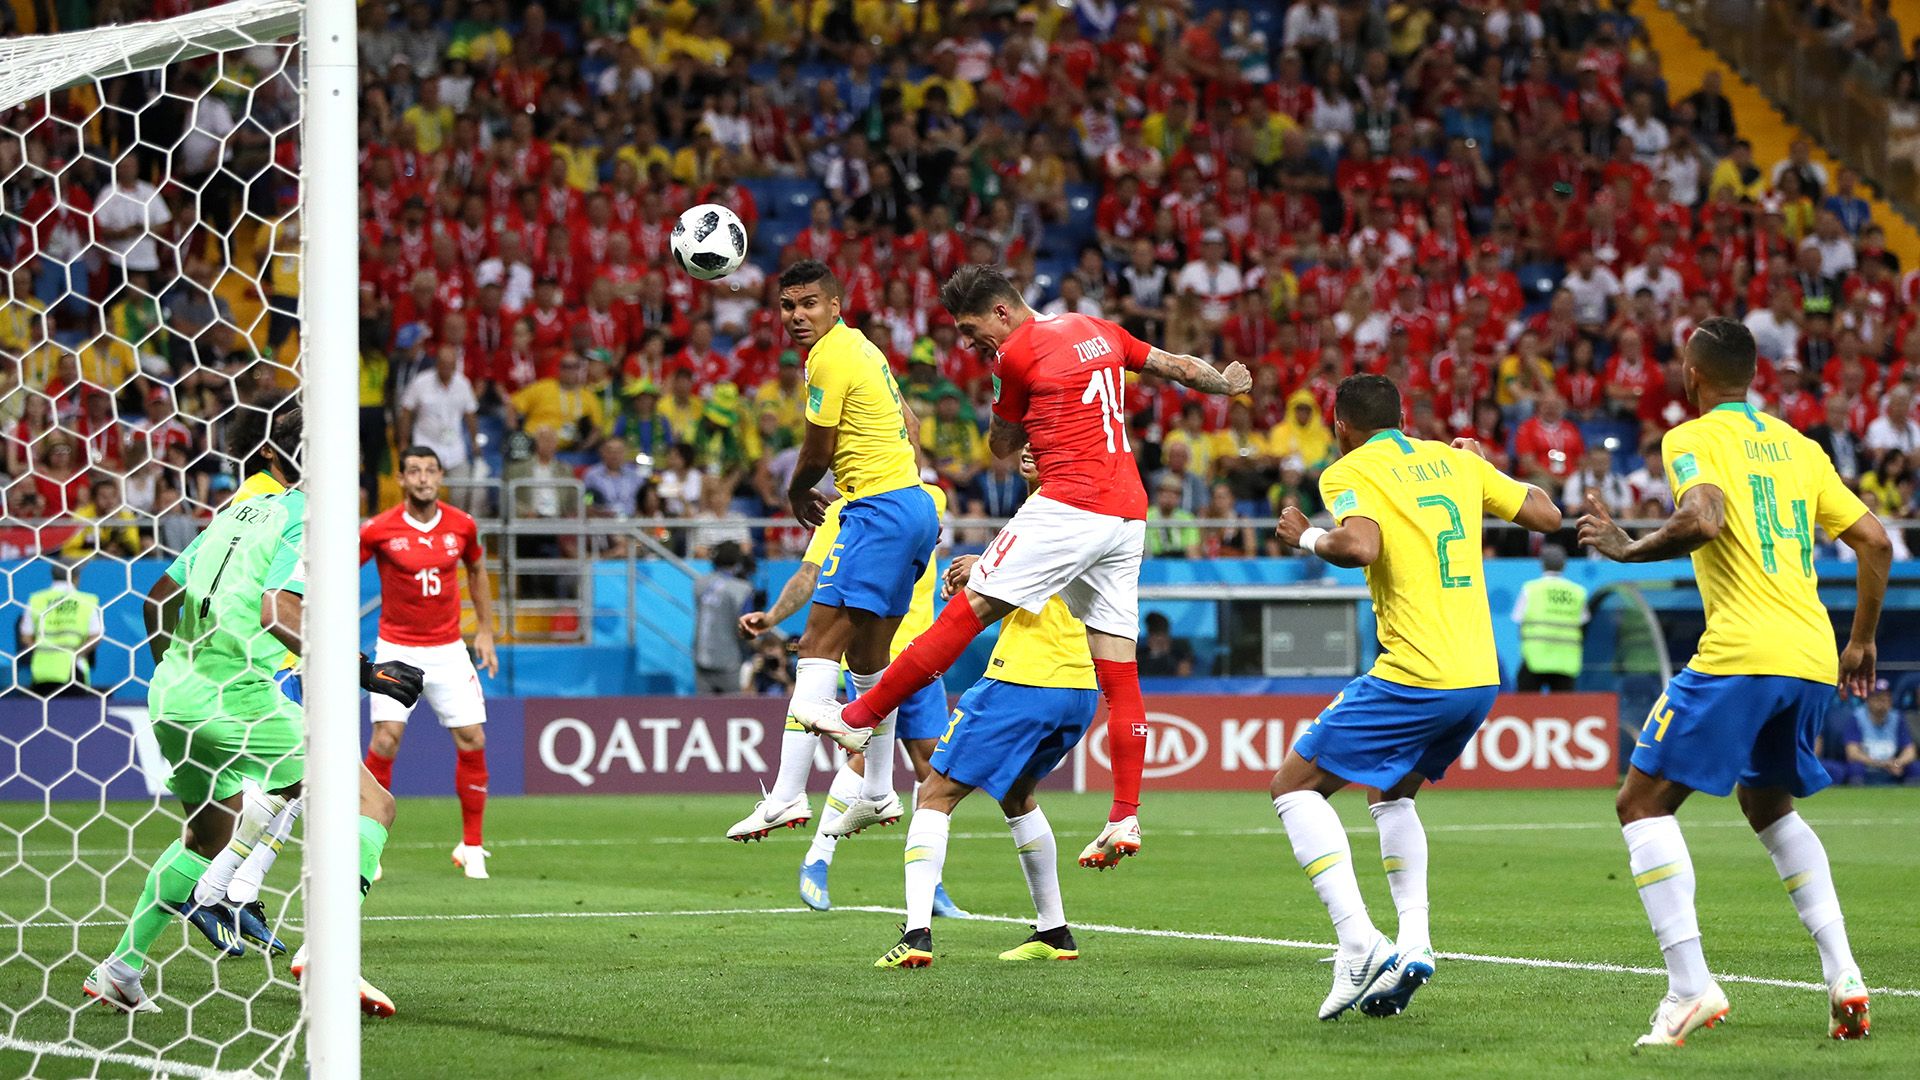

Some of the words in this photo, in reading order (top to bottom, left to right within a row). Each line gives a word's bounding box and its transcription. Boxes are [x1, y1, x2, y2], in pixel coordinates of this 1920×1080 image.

[1073, 335, 1112, 363] ZUBER
[1081, 366, 1132, 453] 14
[1409, 459, 1453, 482] SILVA
[983, 529, 1017, 567] 14
[1417, 494, 1473, 588] 2
[1747, 474, 1812, 578] 14
[200, 536, 242, 619] 1
[414, 567, 442, 597] 15
[822, 543, 845, 577] 5
[940, 708, 965, 744] 3
[1642, 692, 1675, 743] 14
[538, 716, 768, 787] QATAR
[1460, 715, 1611, 772] ORS
